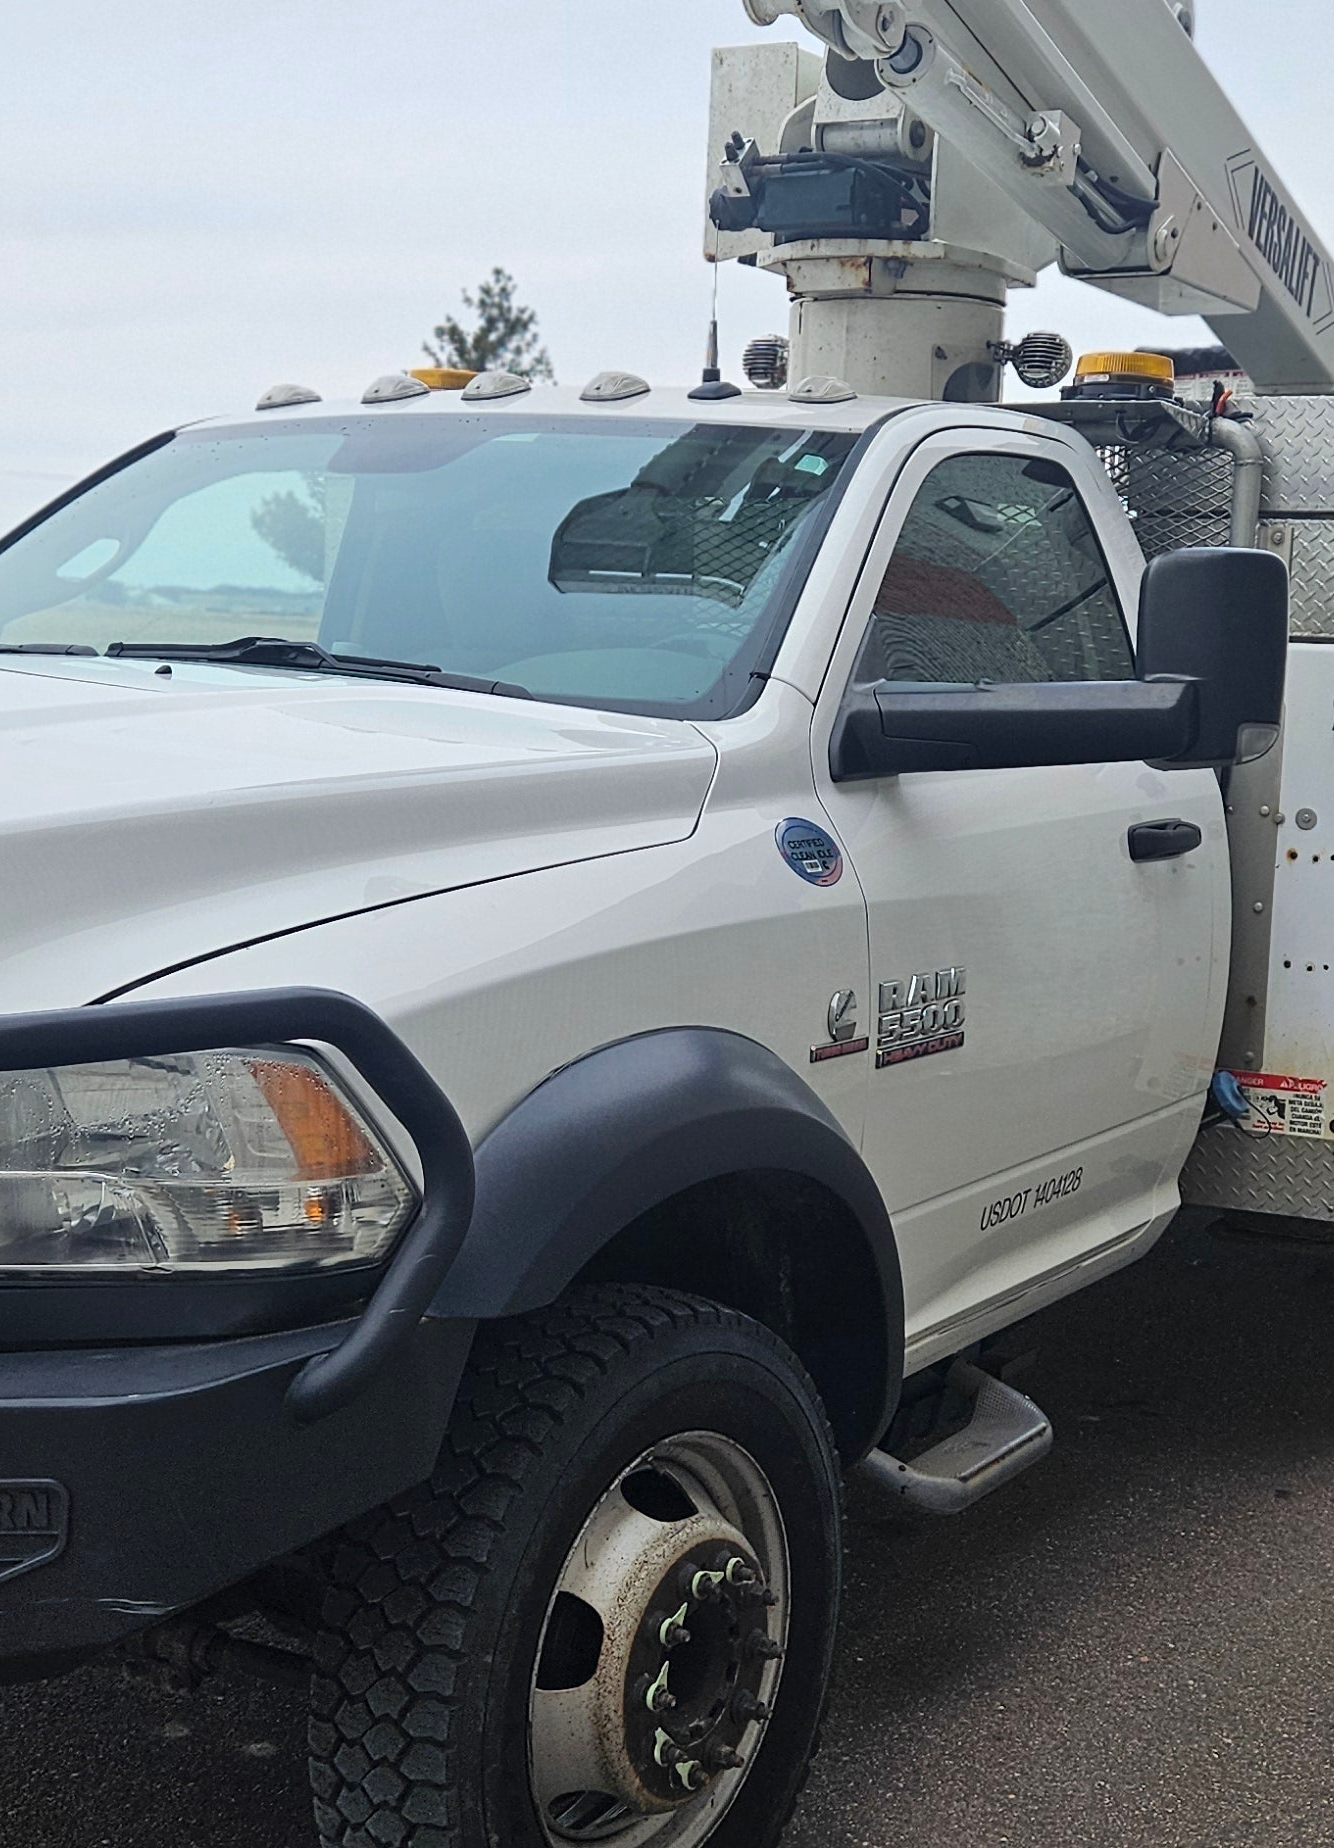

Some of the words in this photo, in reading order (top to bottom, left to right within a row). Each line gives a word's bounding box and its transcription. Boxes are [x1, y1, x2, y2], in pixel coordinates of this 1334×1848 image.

[1248, 165, 1320, 318] VERSALIFT
[787, 838, 825, 849] CERTIFIED
[790, 851, 817, 861] CLEAN
[878, 966, 966, 1014] RAM
[877, 997, 966, 1047] 5500
[883, 1040, 928, 1065] HEAVY
[928, 1034, 963, 1056] DUTY
[980, 1188, 1032, 1231] USDOT
[1033, 1166, 1083, 1209] 1404128
